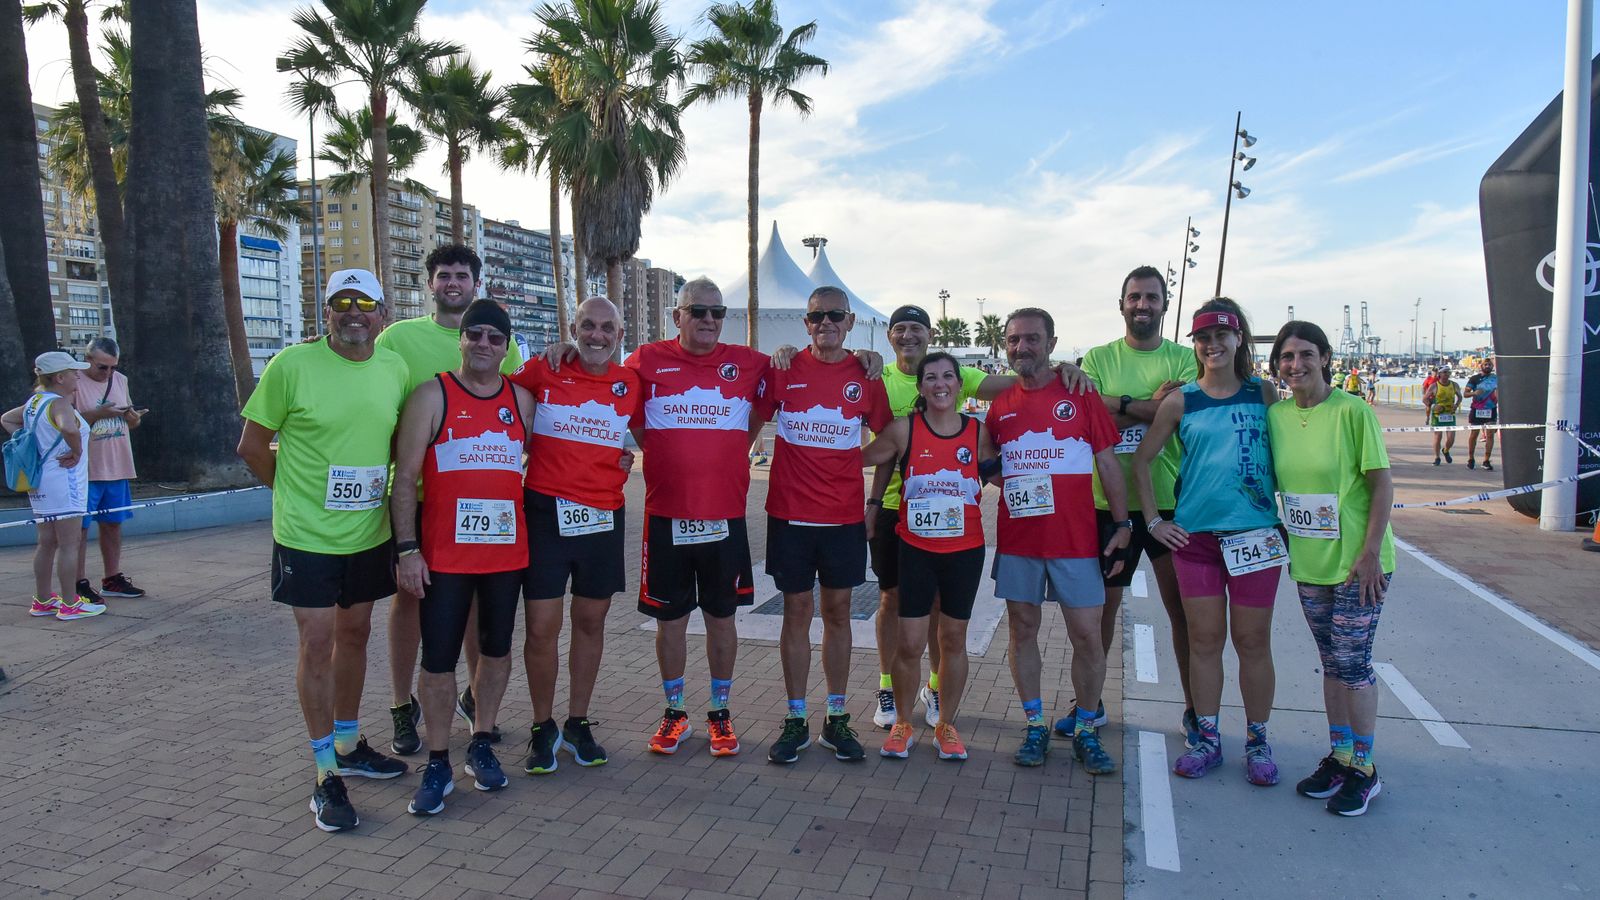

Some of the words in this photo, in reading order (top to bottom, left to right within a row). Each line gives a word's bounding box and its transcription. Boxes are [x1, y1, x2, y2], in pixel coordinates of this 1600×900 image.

[663, 404, 688, 415] SAN
[691, 404, 732, 417] ROQUE
[569, 414, 611, 428] RUNNING
[677, 416, 717, 425] RUNNING
[553, 421, 580, 435] SAN
[582, 427, 622, 442] ROQUE
[787, 420, 810, 431] SAN
[812, 422, 851, 436] ROQUE
[797, 433, 836, 444] RUNNING
[1119, 429, 1143, 443] 755
[472, 444, 507, 452] RUNNING
[1005, 450, 1022, 462] SAN
[1025, 448, 1065, 460] ROQUE
[459, 453, 483, 464] SAN
[485, 454, 516, 465] ROQUE
[1013, 461, 1050, 470] RUNNING
[332, 482, 362, 499] 550
[927, 480, 960, 488] RUNNING
[1008, 490, 1030, 507] 954
[461, 515, 490, 531] 479
[563, 508, 590, 525] 366
[915, 511, 941, 527] 847
[1289, 508, 1312, 526] 860
[679, 519, 705, 534] 953
[1231, 544, 1262, 564] 754
